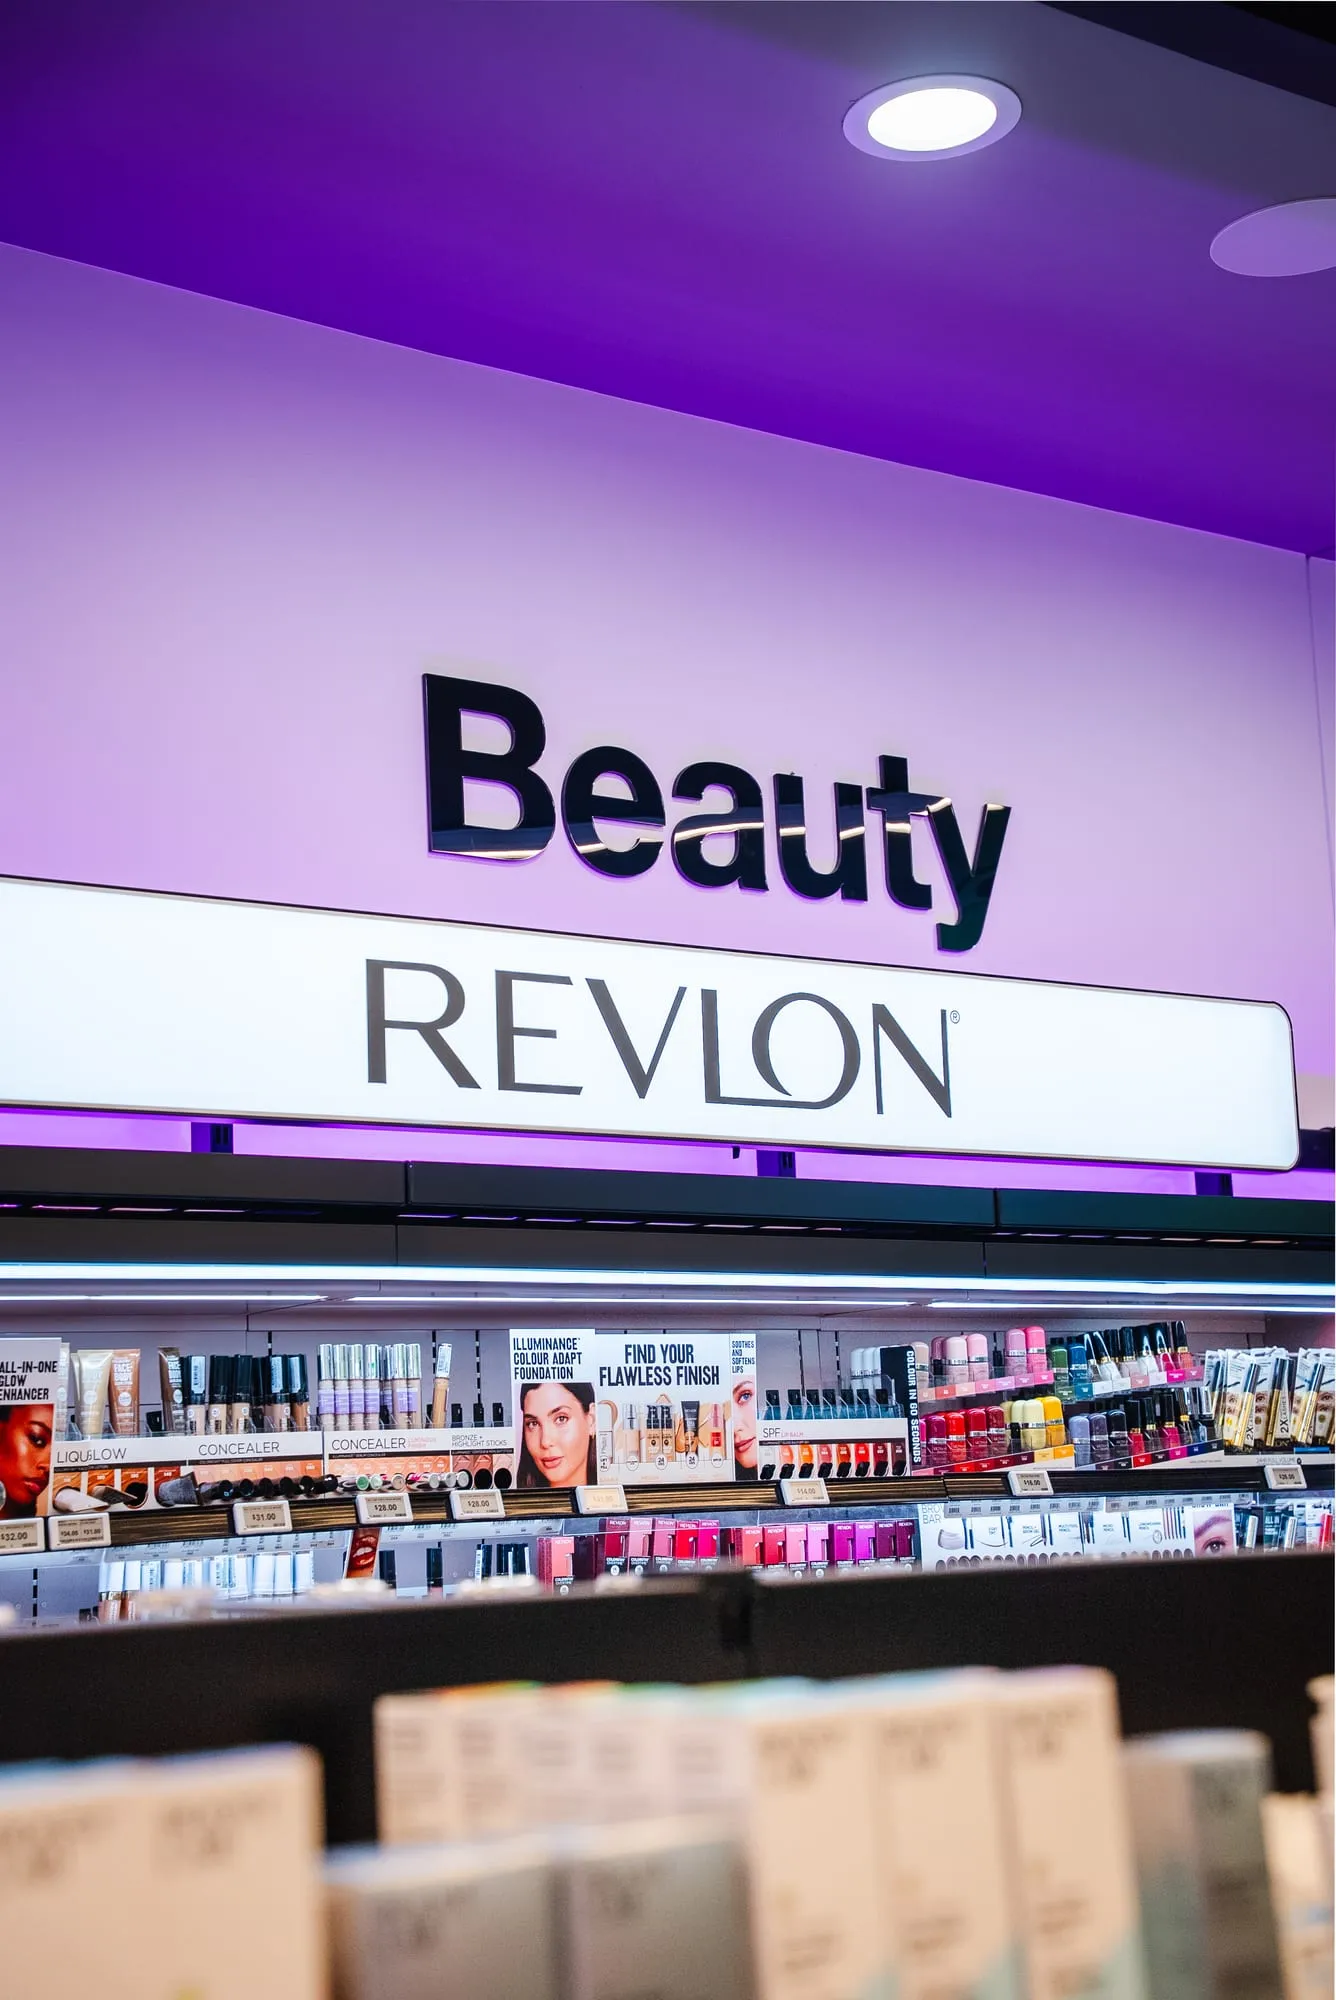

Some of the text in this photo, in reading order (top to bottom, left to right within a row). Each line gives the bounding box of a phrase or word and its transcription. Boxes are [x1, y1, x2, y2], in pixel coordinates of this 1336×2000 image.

[422, 672, 1011, 952] Beauty
[513, 1337, 578, 1350] ILLUMINANCE
[732, 1340, 754, 1348] SOOTHES
[513, 1351, 582, 1365] COLOUR ADAPT
[624, 1343, 694, 1364] FIND YOUR
[0, 1360, 58, 1373] ALL-IN-ONE
[732, 1357, 755, 1365] SOFTENS
[514, 1366, 574, 1380] FOUNDATION
[906, 1350, 916, 1387] COLOUR
[0, 1374, 27, 1387] GLOW
[599, 1365, 720, 1387] FLAWLESS FINISH
[908, 1388, 918, 1400] IN
[763, 1427, 781, 1438] SPF
[332, 1437, 406, 1451] CONCEALER
[910, 1418, 921, 1463] SECONDS
[198, 1441, 280, 1456] CONCEALER
[797, 1487, 816, 1495] $14.00
[374, 1503, 397, 1512] $28.00
[468, 1500, 490, 1508] $28.00
[252, 1512, 276, 1521] $31.00
[922, 1514, 941, 1524] BAR
[0, 1531, 28, 1541] $32.00
